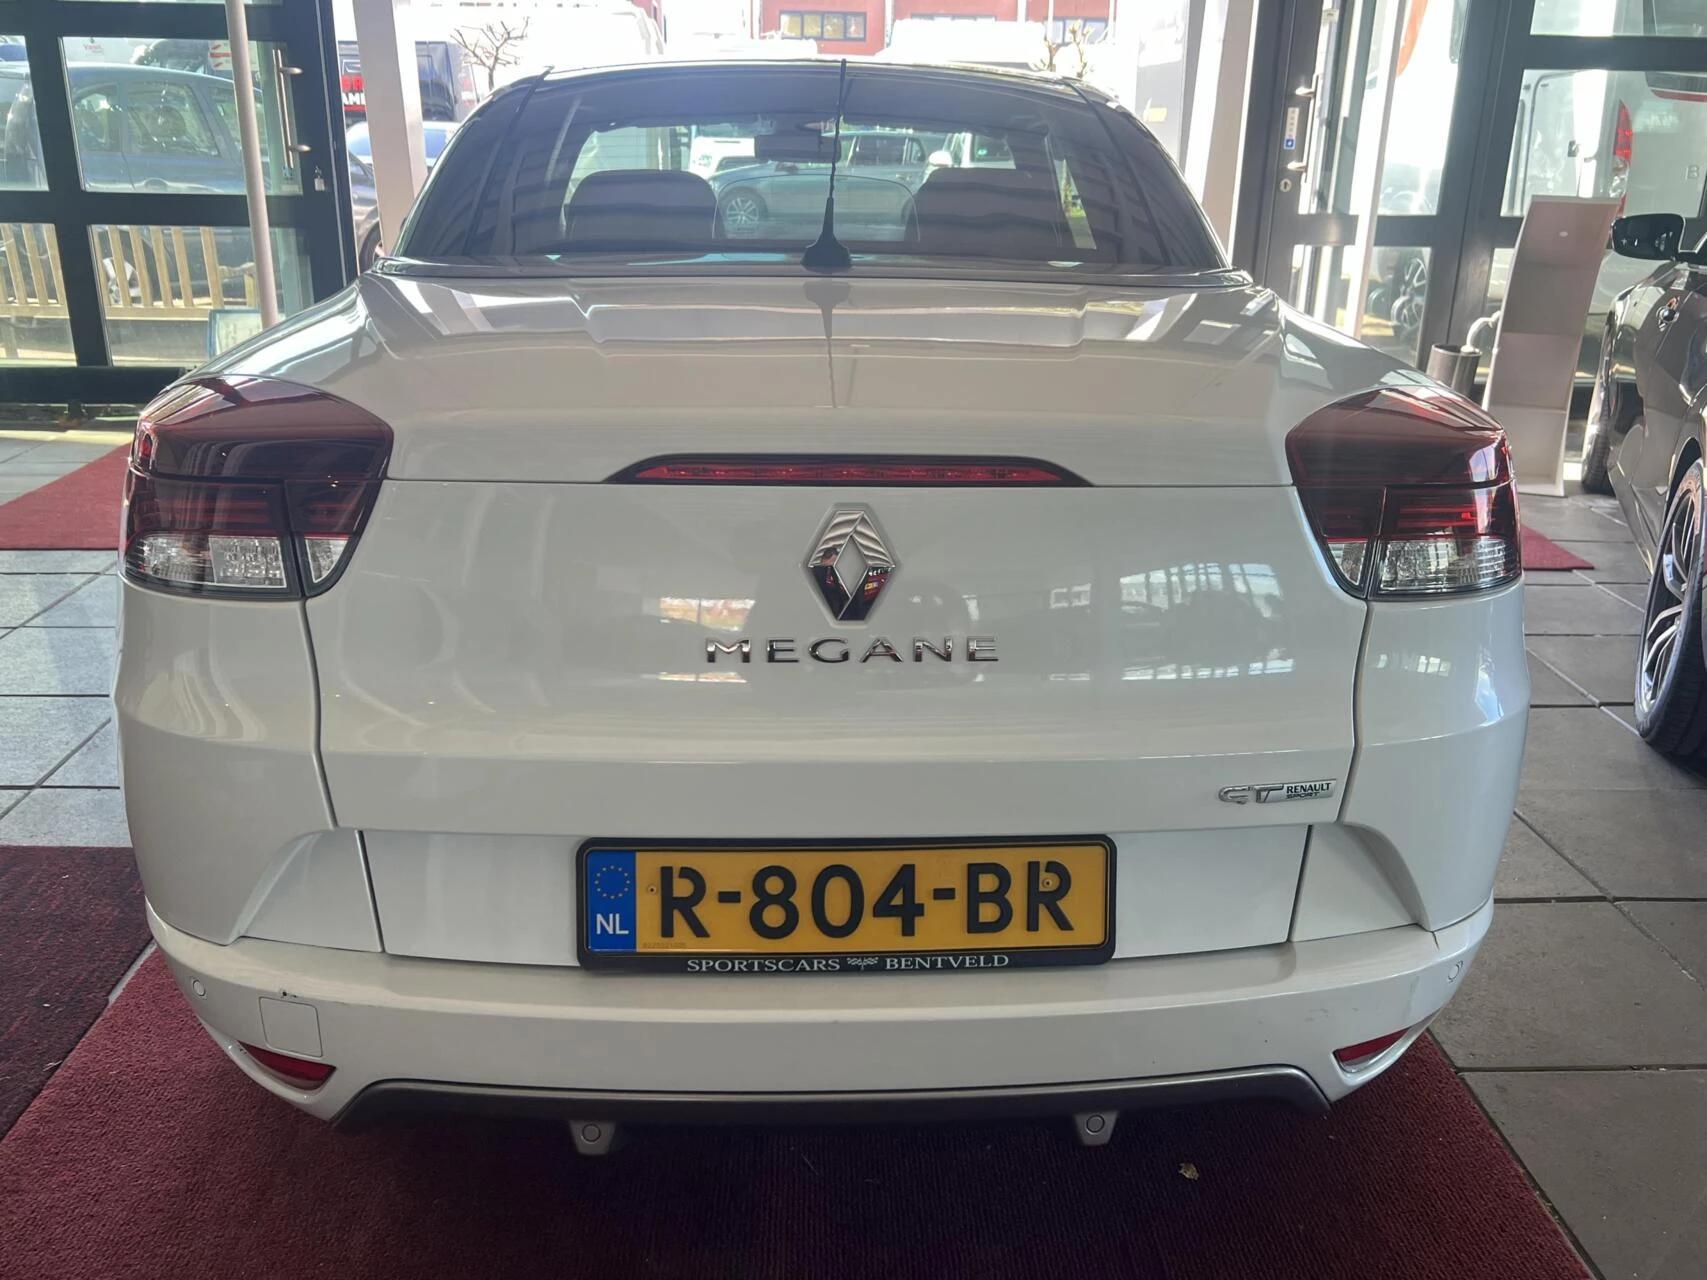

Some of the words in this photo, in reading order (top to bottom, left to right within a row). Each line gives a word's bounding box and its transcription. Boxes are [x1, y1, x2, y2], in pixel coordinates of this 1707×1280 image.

[706, 636, 999, 663] MEGANE
[1218, 783, 1284, 804] GT
[1286, 782, 1332, 794] RENAULT
[660, 861, 1074, 939] R-804-BR
[596, 913, 629, 935] NL
[687, 958, 841, 972] SPORTSCARS
[885, 954, 1009, 970] BENTVELD
